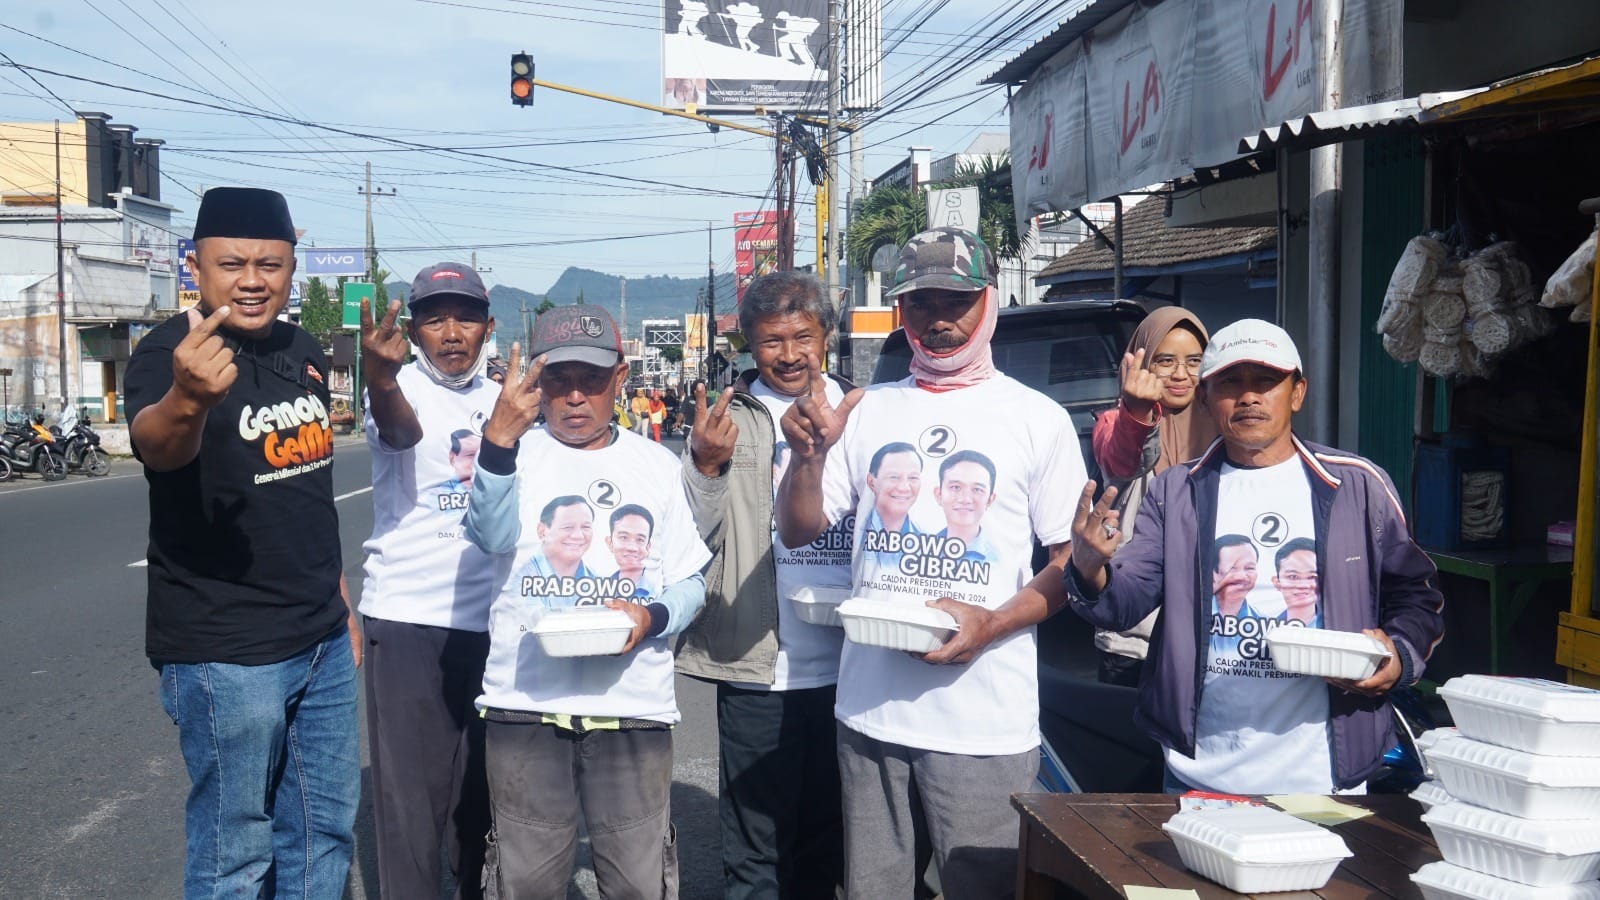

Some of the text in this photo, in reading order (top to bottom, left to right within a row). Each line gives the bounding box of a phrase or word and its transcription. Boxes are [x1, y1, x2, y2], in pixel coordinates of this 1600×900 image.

[737, 240, 751, 251] AYO
[315, 253, 355, 265] vivo
[239, 394, 330, 441] Gemoy
[926, 427, 949, 454] 2
[597, 481, 614, 506] 2
[1260, 515, 1280, 543] 2
[864, 529, 967, 559] RABOWO
[790, 550, 818, 558] CALON
[806, 558, 829, 566] WAKIL
[899, 553, 990, 585] GIBRAN
[521, 575, 636, 597] PRABOWO
[909, 575, 952, 590] PRESIDEN
[893, 584, 921, 596] WAKIL
[922, 588, 966, 601] PRESIDEN
[968, 593, 987, 603] 2024
[1215, 657, 1276, 670] CALON PRESI
[1232, 668, 1262, 678] WAKIL
